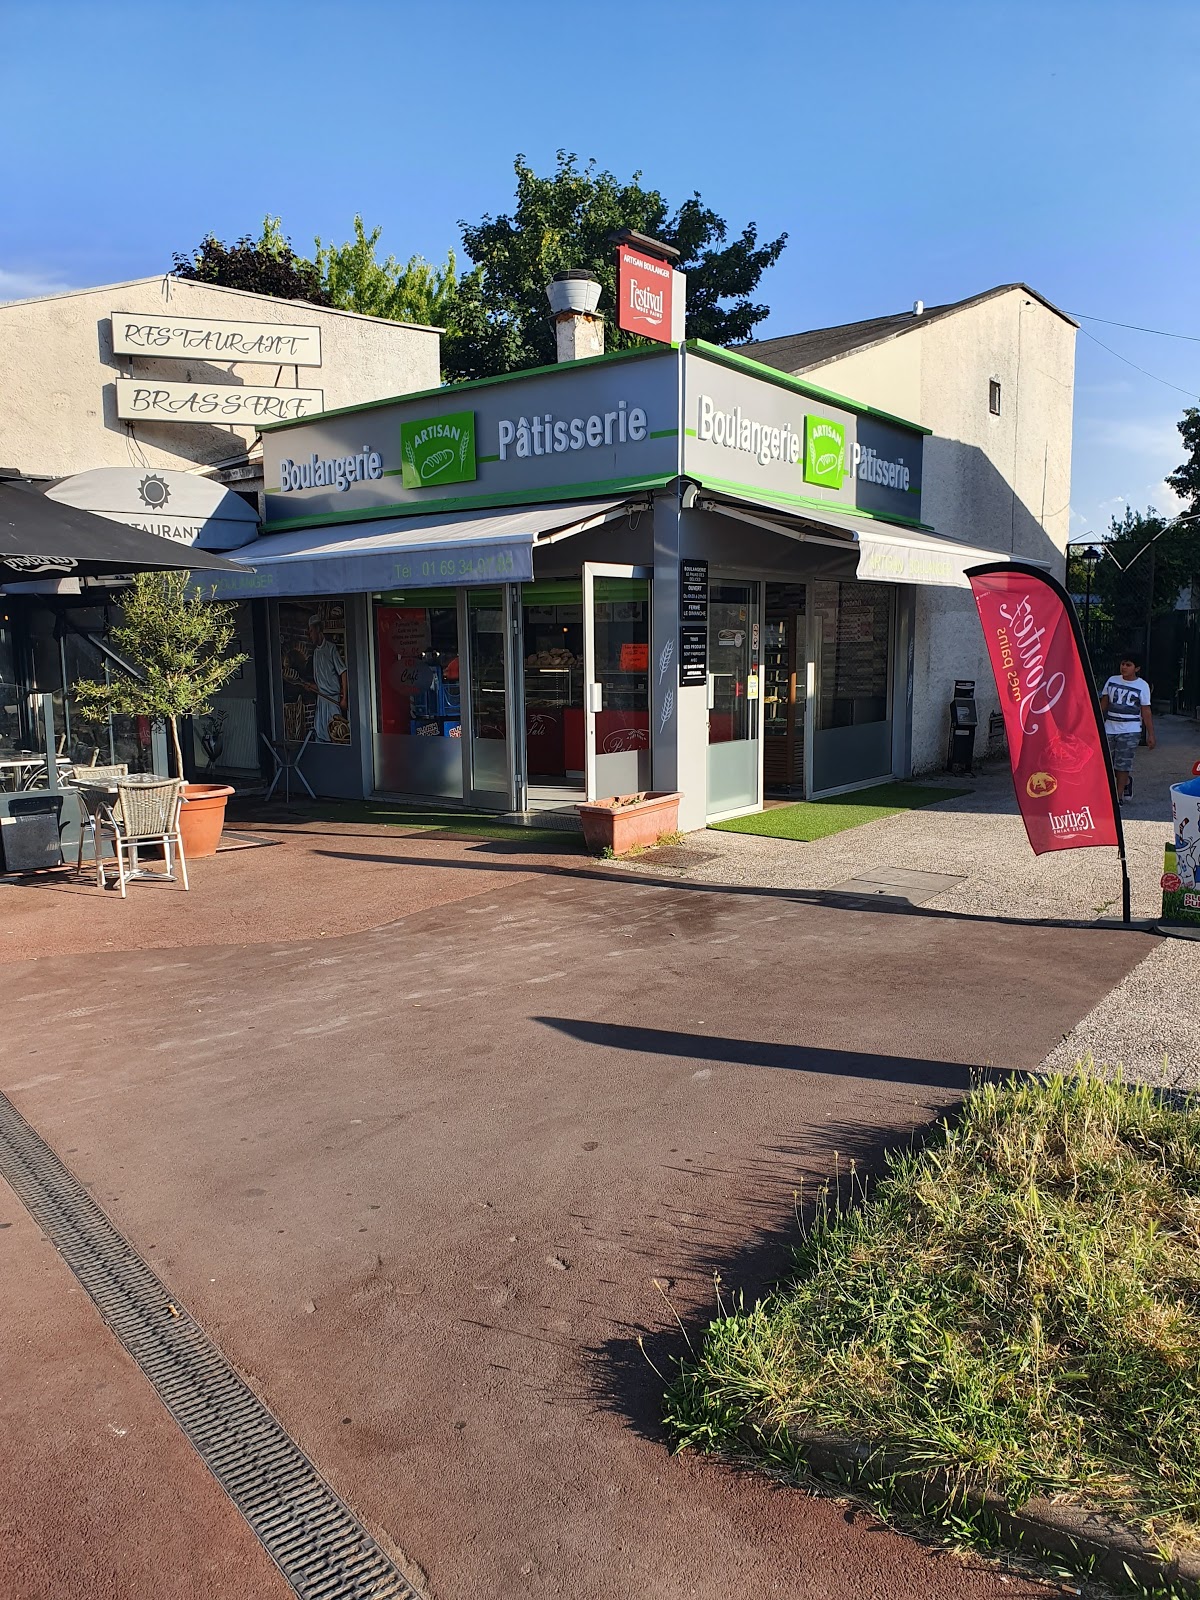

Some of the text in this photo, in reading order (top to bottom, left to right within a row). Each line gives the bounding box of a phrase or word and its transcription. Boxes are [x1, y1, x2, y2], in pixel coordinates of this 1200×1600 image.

[623, 254, 670, 278] ARTISAN BOULANGER
[630, 279, 663, 313] Festival
[124, 324, 309, 355] RESTAURANT
[129, 389, 312, 418] BRASSERIE
[413, 425, 461, 449] ARTISAN
[498, 400, 648, 460] Pâtisserie
[698, 394, 800, 465] Boulangerie
[812, 424, 842, 446] ARTISAN
[279, 445, 384, 492] Boulangerie
[850, 442, 910, 491] Pâtisserie
[124, 523, 203, 539] TAURANT
[422, 561, 436, 576] 01
[440, 559, 456, 576] 69
[458, 559, 473, 575] 34
[1107, 686, 1139, 707] NYC
